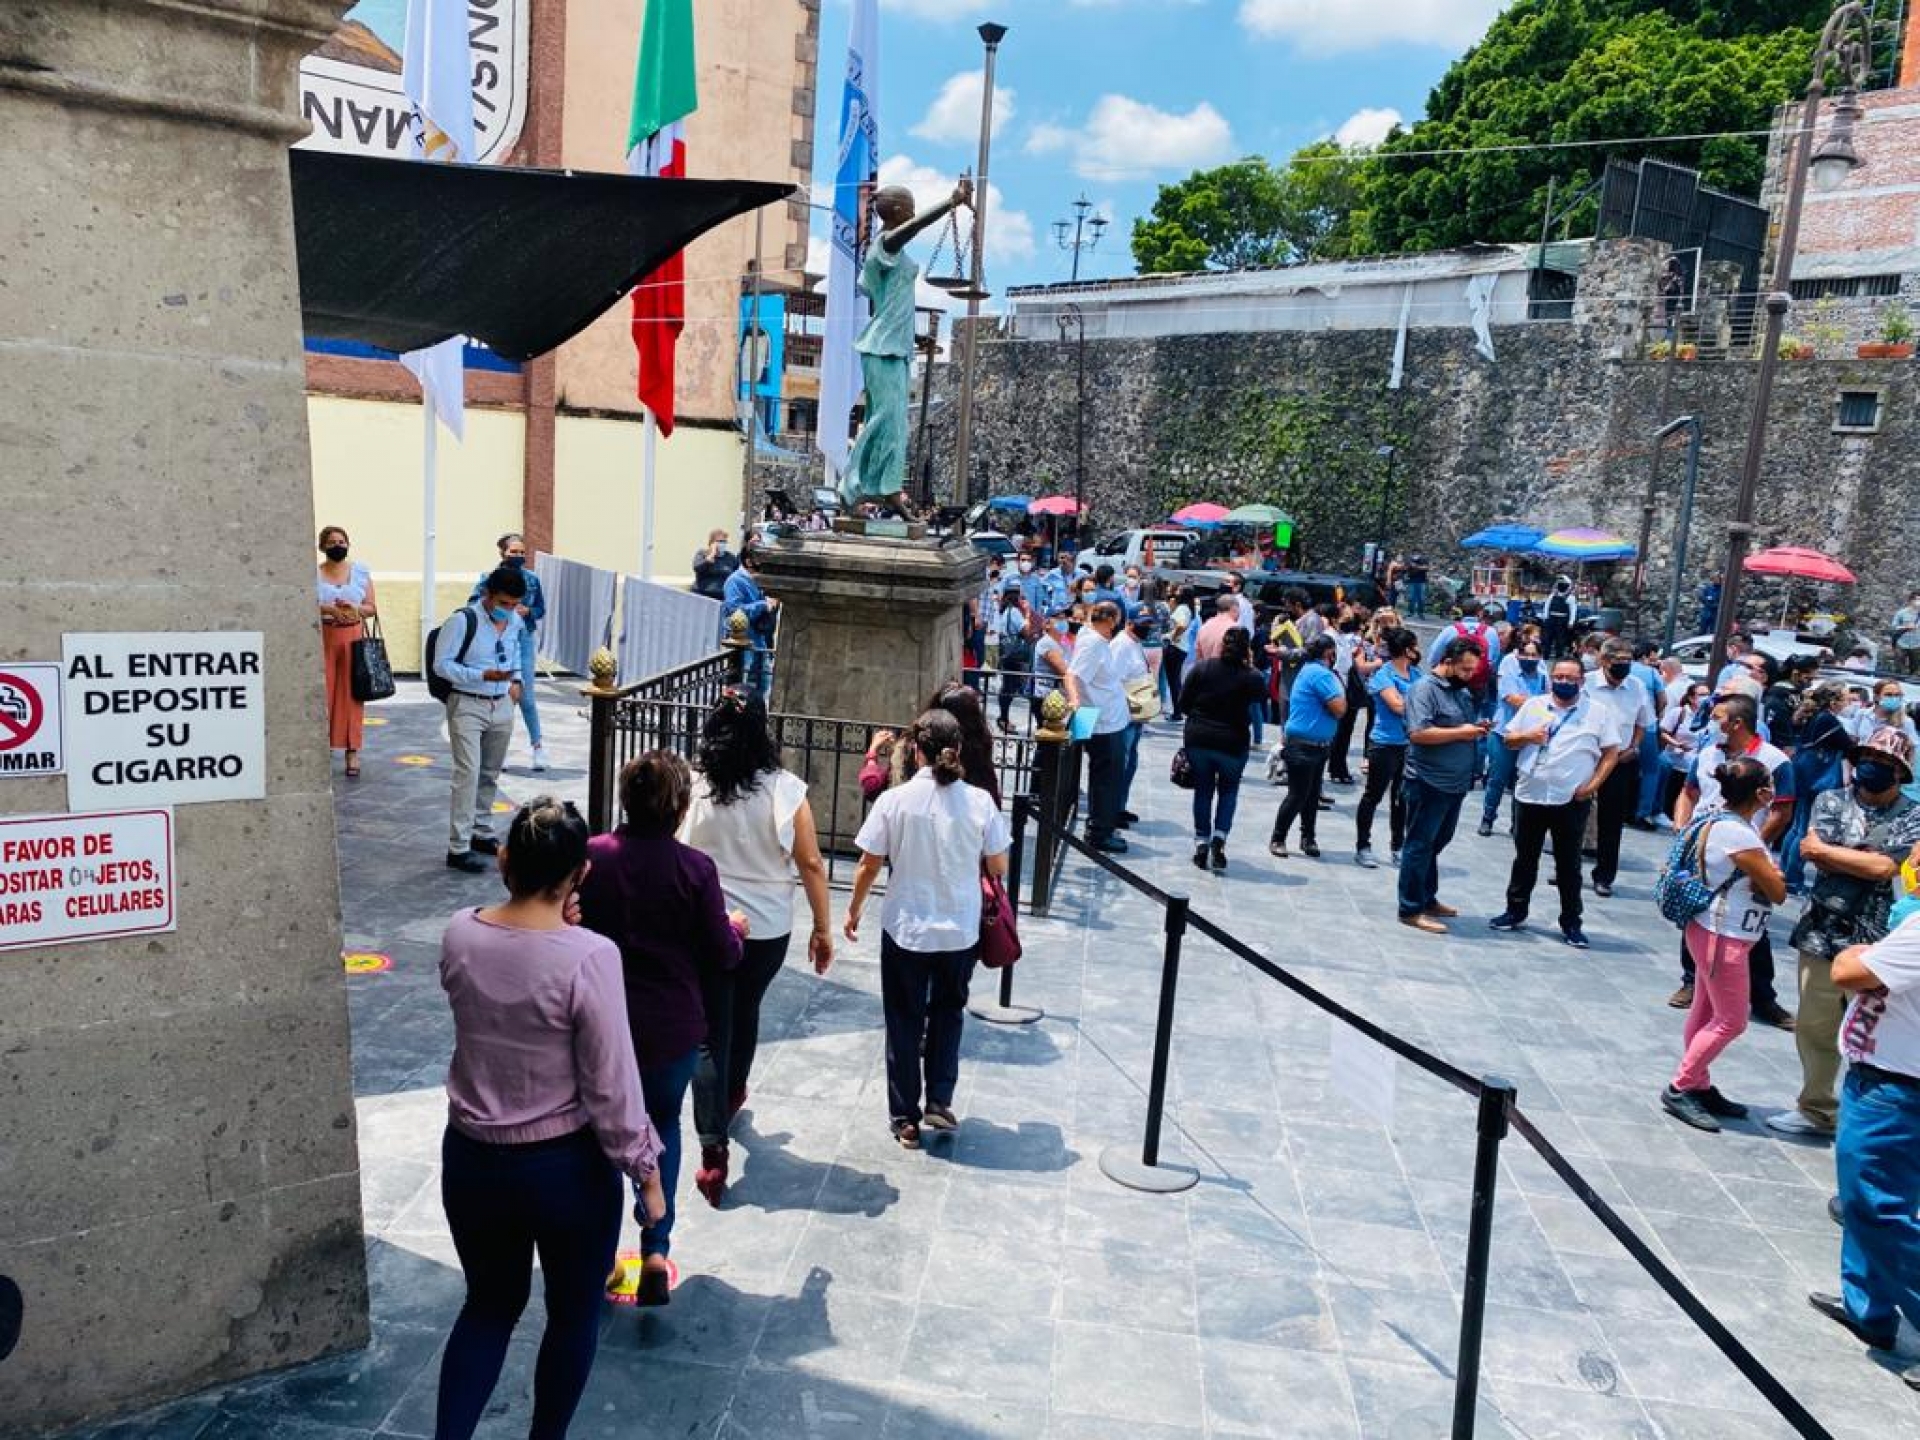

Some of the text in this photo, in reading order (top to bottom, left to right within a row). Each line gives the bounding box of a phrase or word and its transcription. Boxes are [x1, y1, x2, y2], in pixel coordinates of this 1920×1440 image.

[68, 651, 260, 680] AL ENTRAR
[84, 686, 248, 715] DEPOSITE
[146, 723, 190, 748] SU
[91, 754, 243, 786] CIGARRO
[3, 833, 113, 863] FAVOR DE
[65, 888, 164, 918] CELULARES
